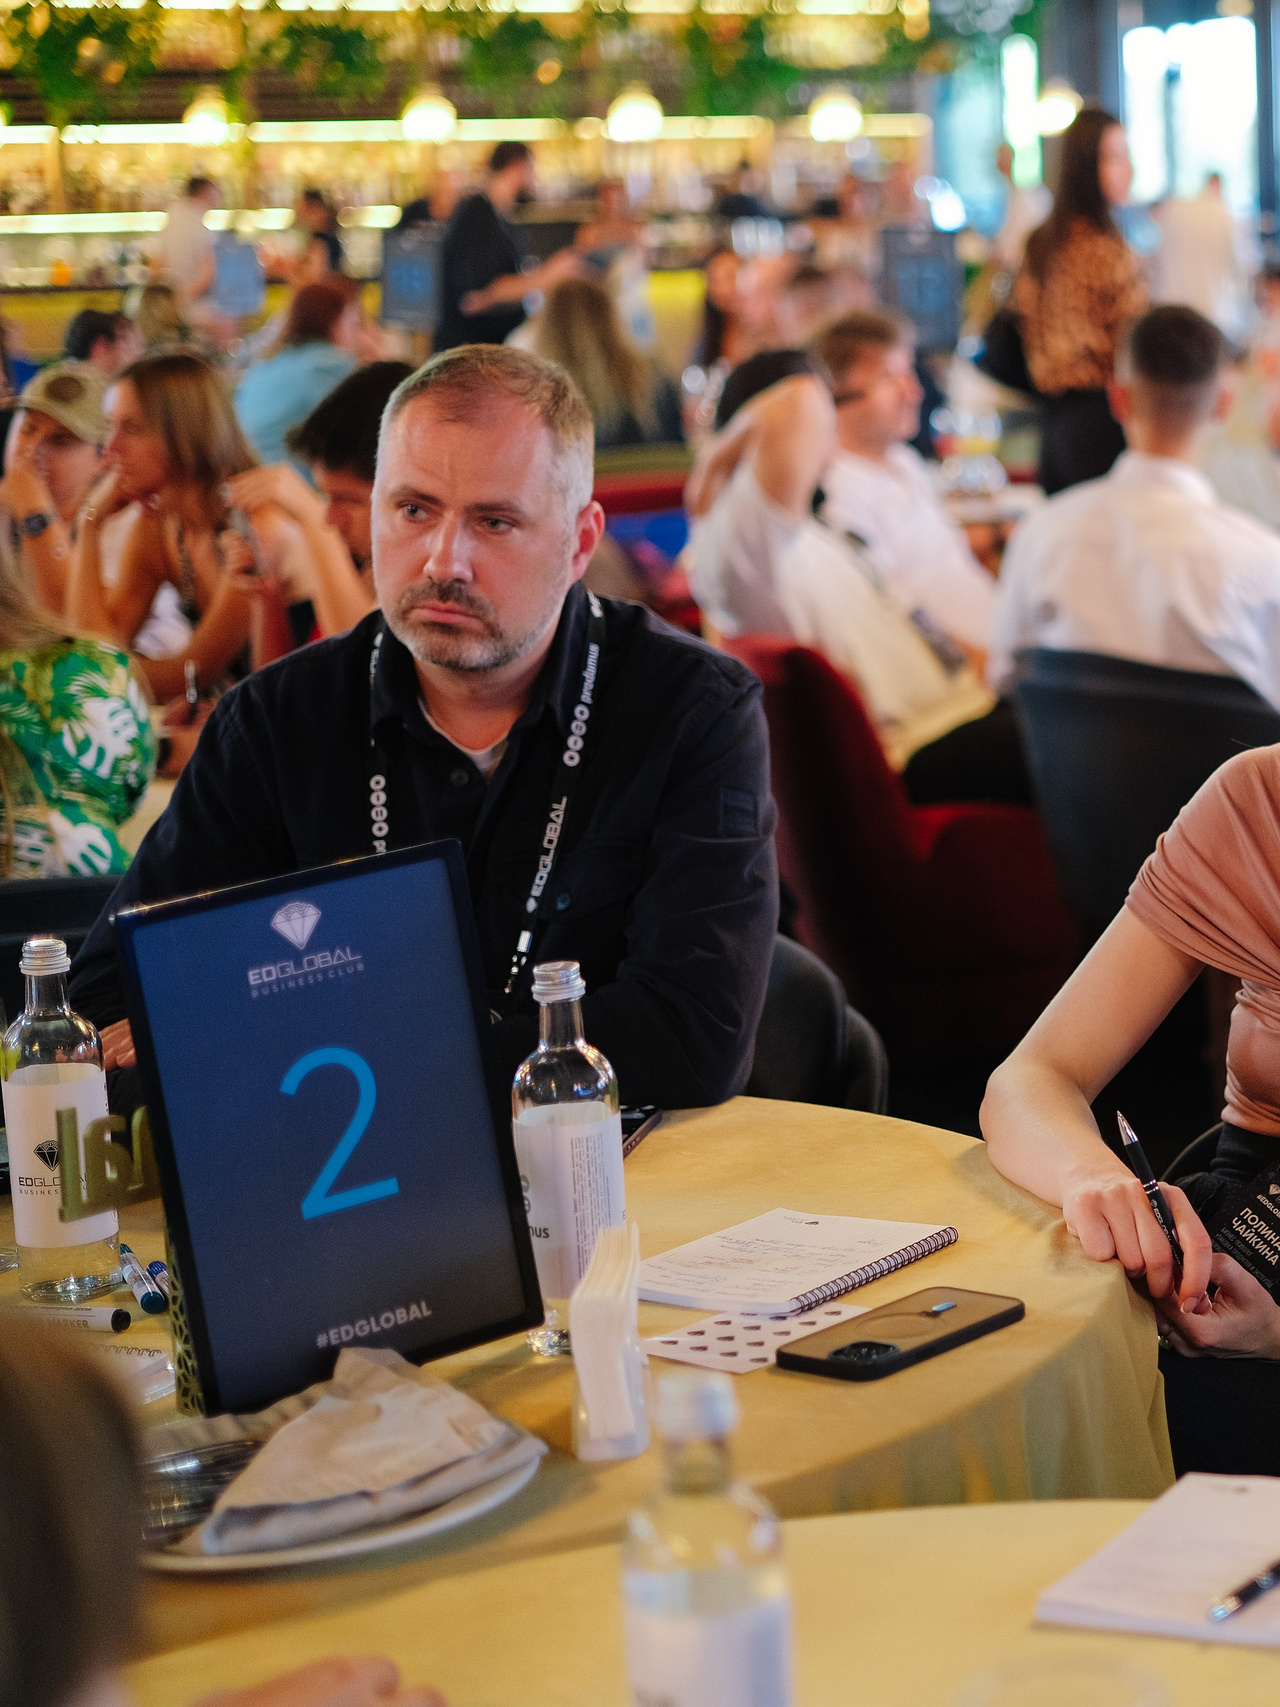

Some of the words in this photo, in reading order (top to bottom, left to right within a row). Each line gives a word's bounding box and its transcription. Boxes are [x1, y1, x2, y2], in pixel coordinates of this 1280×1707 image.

[530, 796, 568, 897] EDGLOBAL
[248, 947, 362, 985] EDGLOBAL
[251, 973, 324, 998] BUSINESS
[328, 963, 365, 979] CLUB
[279, 1046, 400, 1220] 2
[18, 1176, 62, 1187] EDGLO
[1231, 1217, 1279, 1266] ЧАЙКИНА
[317, 1301, 432, 1348] #EDGLOBAL
